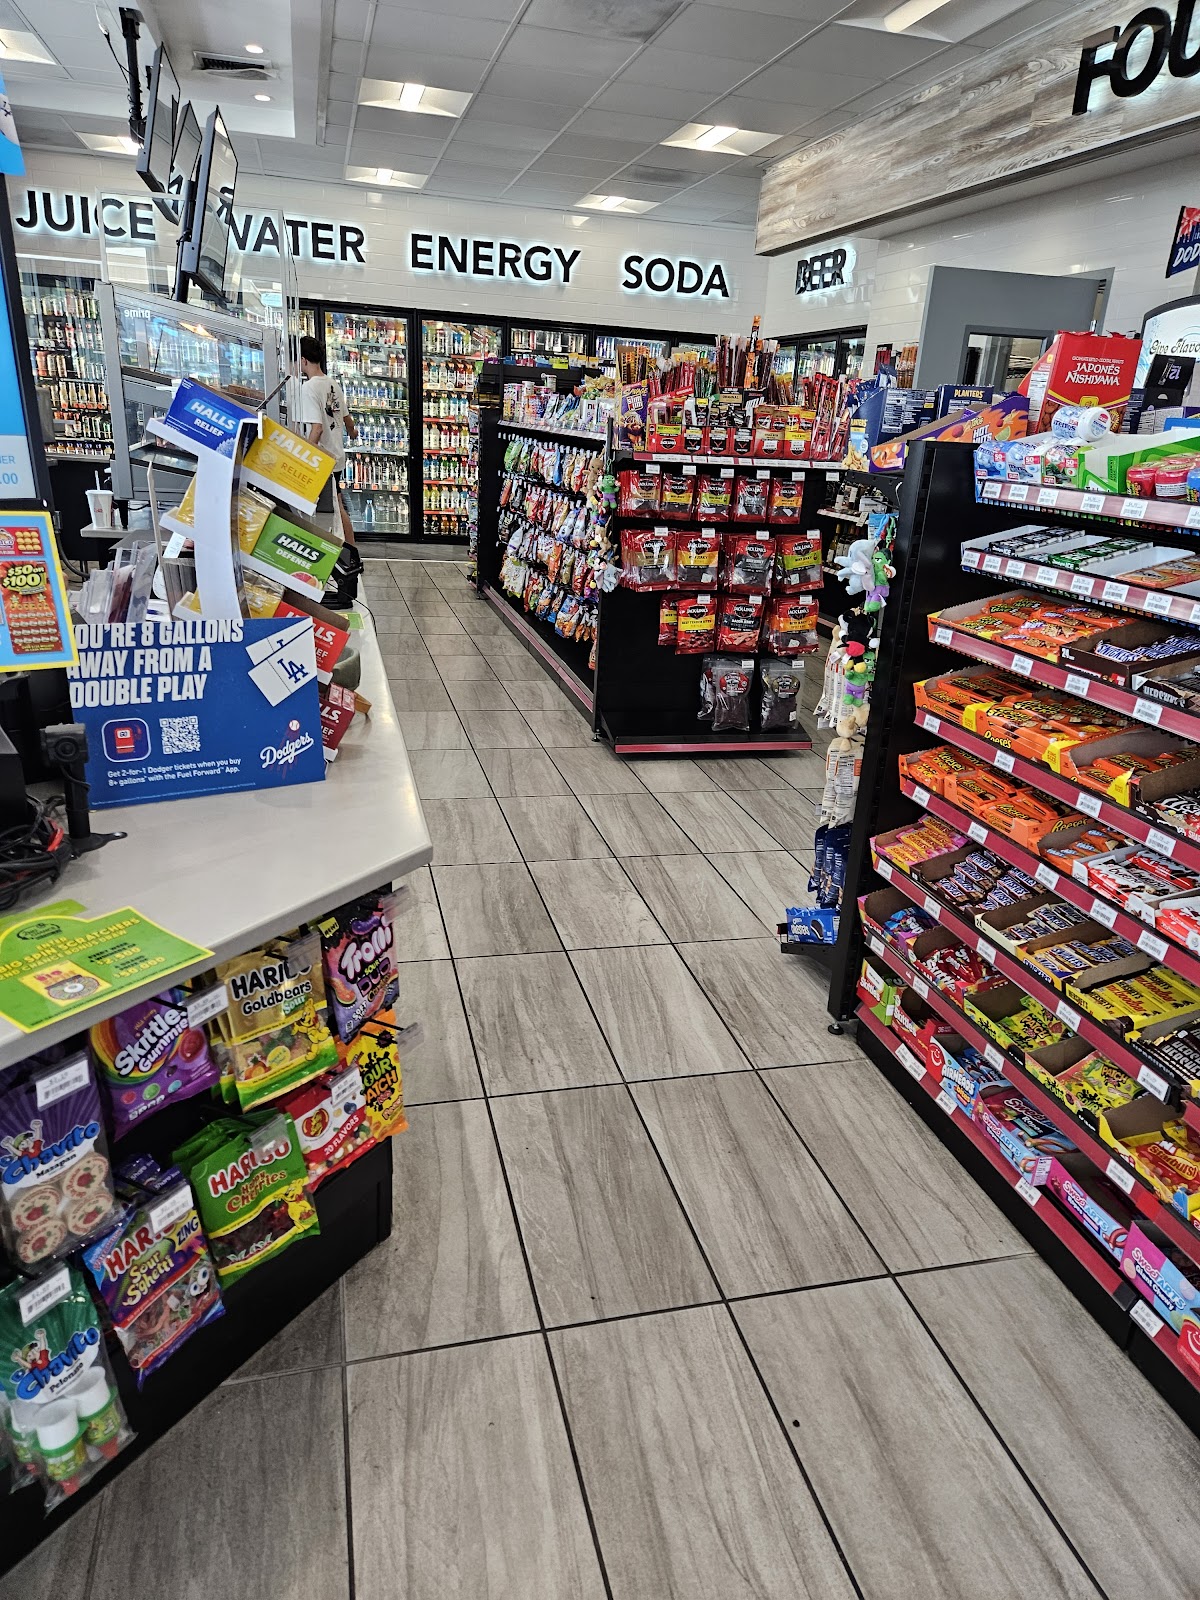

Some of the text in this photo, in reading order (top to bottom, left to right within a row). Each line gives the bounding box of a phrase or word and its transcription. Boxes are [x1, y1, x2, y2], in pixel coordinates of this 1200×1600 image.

[16, 190, 156, 241] JUICE
[411, 233, 581, 283] ENERGY
[621, 255, 730, 298] SODA
[796, 248, 847, 296] BEER
[1065, 371, 1120, 386] NISHIYAMA
[1075, 362, 1120, 376] JAPONÉS
[954, 389, 984, 400] PLANTERS
[190, 401, 237, 430] HALLS
[193, 418, 224, 437] RELIEF
[973, 425, 990, 437] HOT
[994, 453, 1002, 461] 50
[1025, 456, 1034, 464] 50
[1066, 459, 1074, 467] 50
[280, 461, 314, 486] RELIEF
[276, 548, 312, 570] DEFENSE
[277, 535, 320, 561] HALLS
[2, 574, 41, 588] $100
[8, 565, 33, 577] $50
[141, 621, 154, 646] 8
[159, 619, 244, 645] GALLONS
[133, 647, 193, 675] FROM
[198, 646, 213, 671] A
[277, 658, 309, 684] LA
[70, 674, 208, 709] DOUBLE PLAY
[260, 732, 314, 769] Dodgers
[107, 770, 121, 778] Get
[122, 768, 146, 778] 2-for-1
[148, 766, 173, 775] Dodger
[174, 763, 197, 771] tickets
[216, 760, 229, 769] you
[229, 757, 242, 767] buy
[148, 774, 164, 782] with
[164, 772, 176, 780] the
[177, 770, 193, 779] Fuel
[225, 766, 241, 775] App.
[25, 947, 57, 964] SPIN
[58, 917, 142, 950] SCRATCHERS
[36, 936, 68, 951] ENTER
[341, 916, 392, 979] Trolli
[22, 952, 65, 971] CHANCE
[364, 959, 380, 976] SOUR
[242, 981, 313, 1016] Goldbears
[283, 995, 306, 1014] Sour
[894, 1007, 917, 1037] Skittles
[138, 1018, 189, 1072] Gummie
[362, 1058, 392, 1089] OUR
[1101, 1066, 1128, 1083] PATCH
[366, 1070, 398, 1104] ATCH
[324, 1143, 335, 1156] 20
[334, 1114, 360, 1148] FLAVORS
[1022, 1114, 1044, 1135] Ropes
[2, 1121, 100, 1185] Chavito
[36, 1153, 77, 1178] Mazapan
[226, 1170, 287, 1213] Cherries
[176, 1216, 199, 1246] ZING
[129, 1251, 160, 1284] Sour
[1135, 1264, 1153, 1287] Giant
[1152, 1284, 1175, 1312] Chewy
[16, 1327, 100, 1401] Chavito
